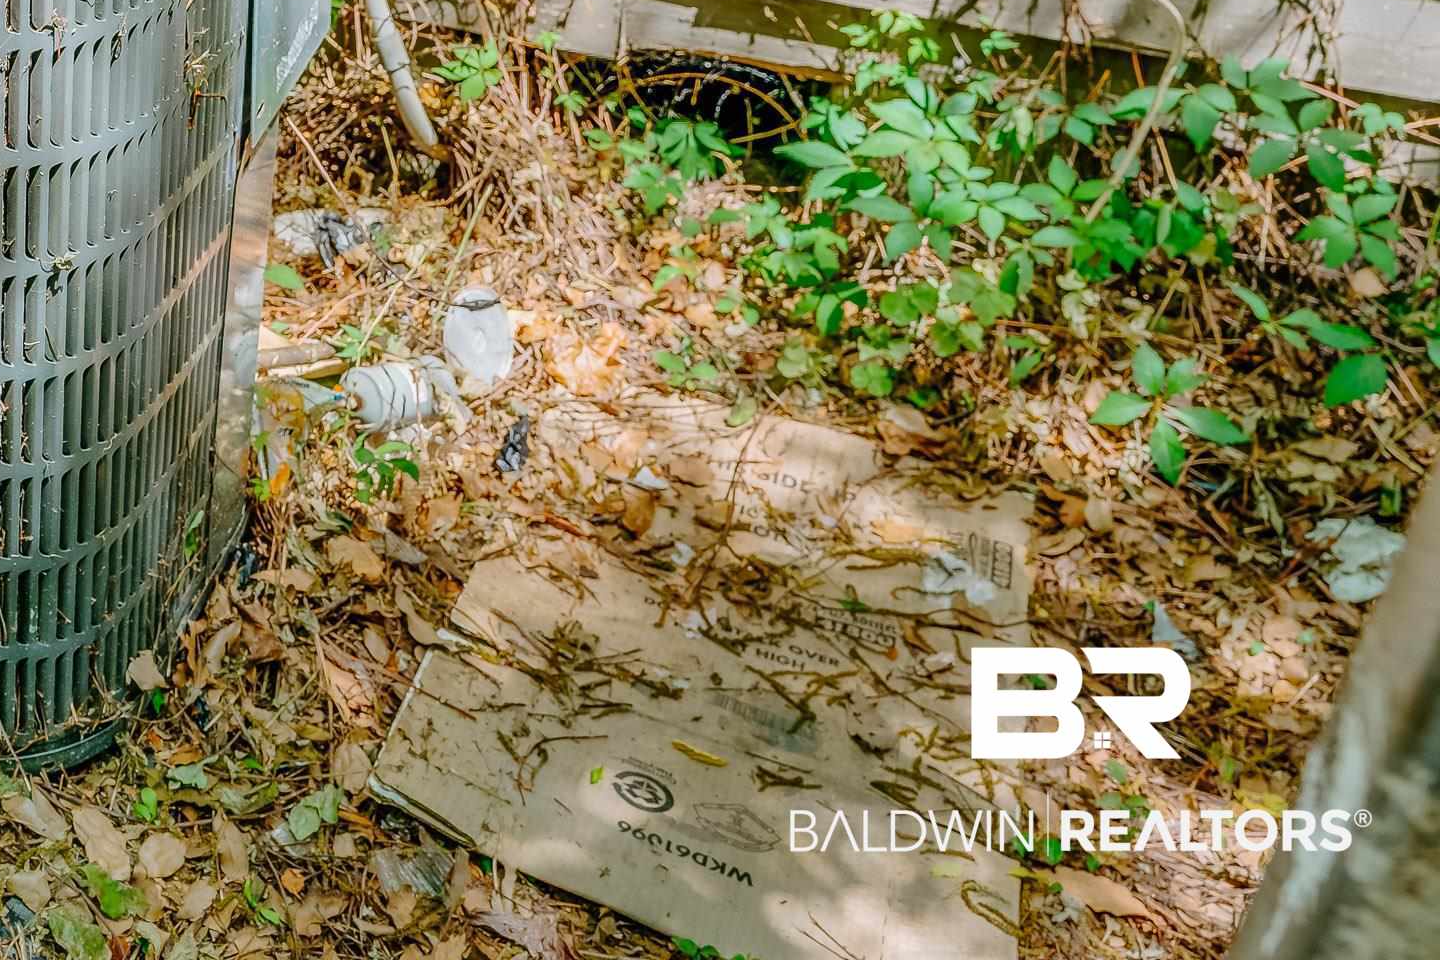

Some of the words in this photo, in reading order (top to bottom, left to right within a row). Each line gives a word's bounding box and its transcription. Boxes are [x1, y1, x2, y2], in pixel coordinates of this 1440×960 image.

[755, 647, 806, 671] HIGH
[788, 644, 840, 668] OVER
[617, 820, 754, 888] WKD61096
